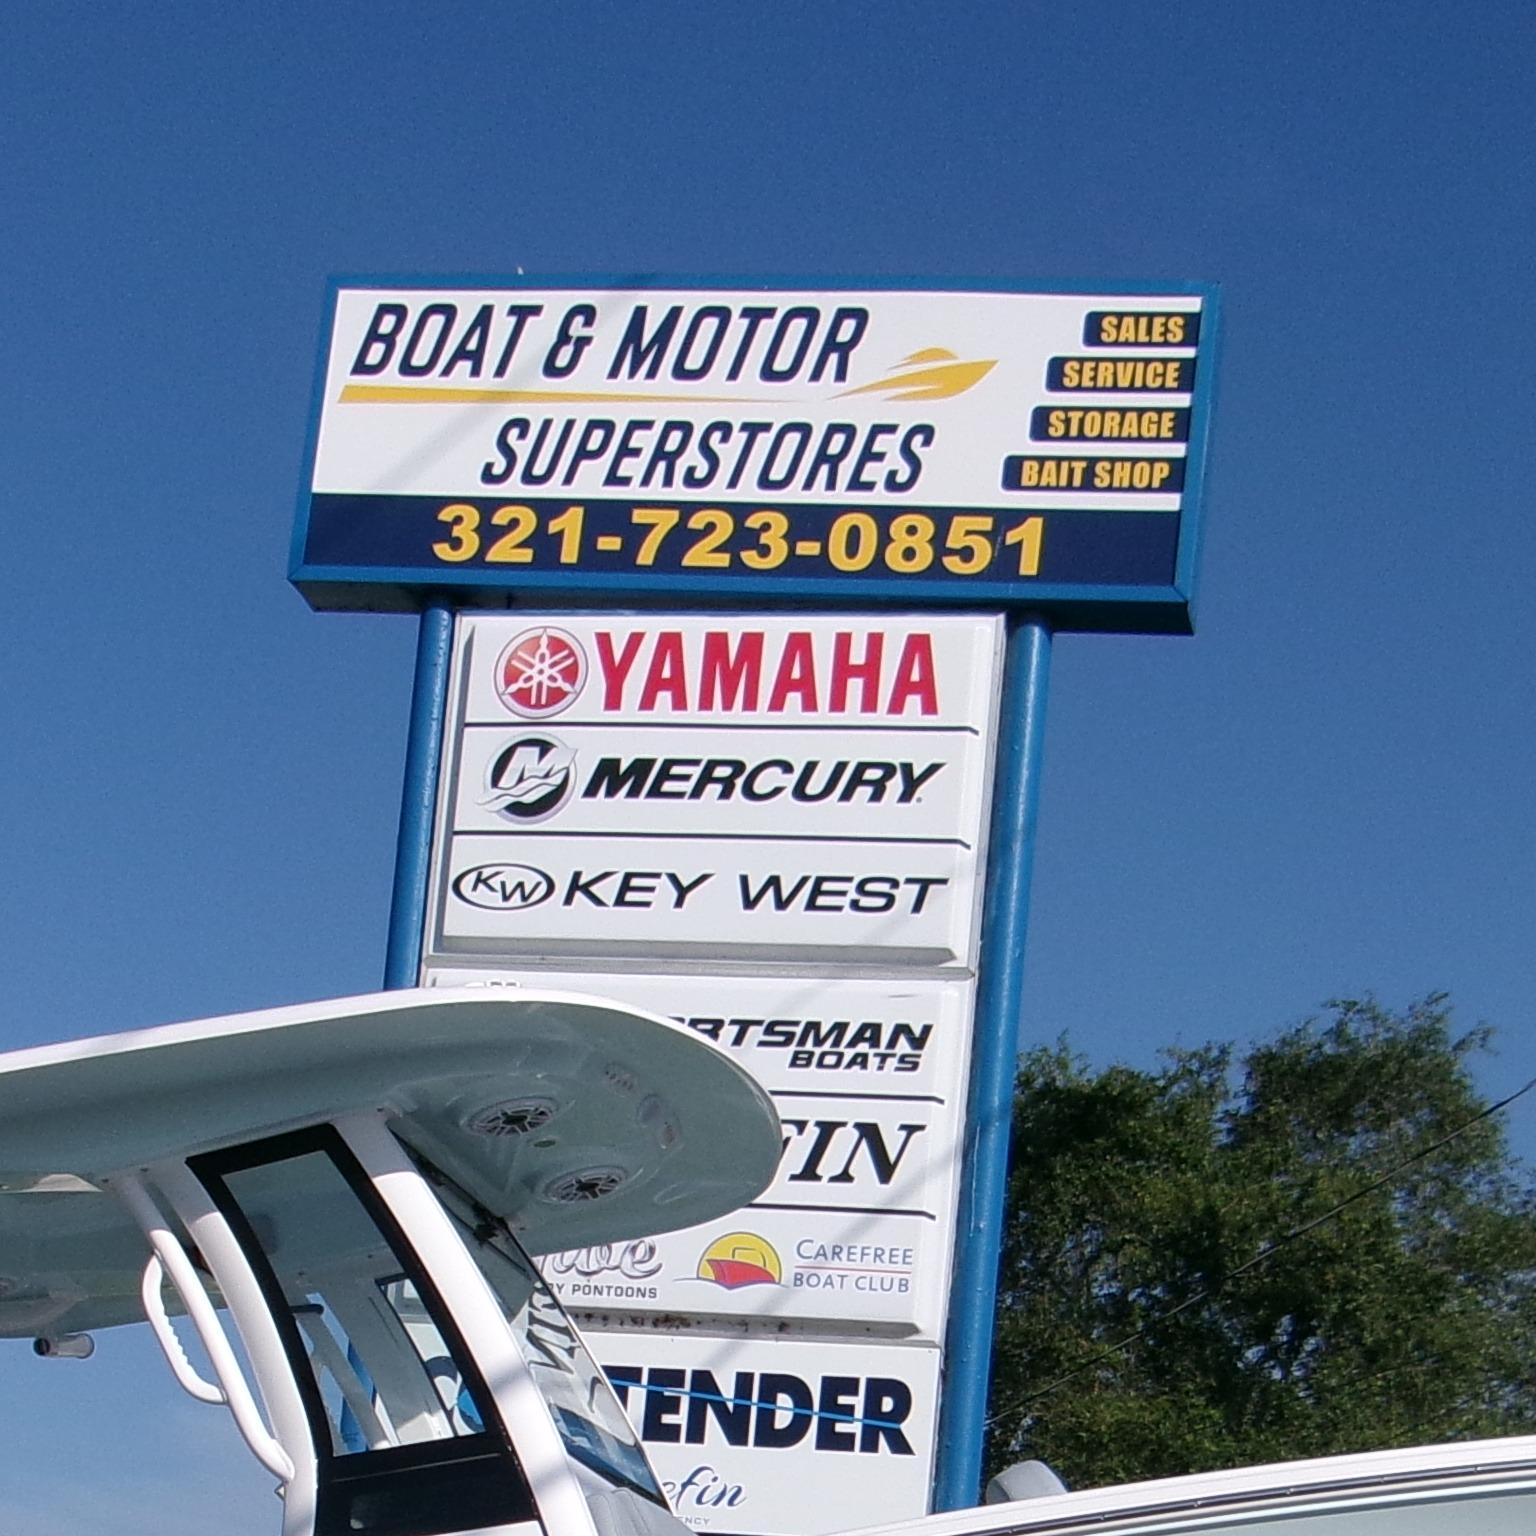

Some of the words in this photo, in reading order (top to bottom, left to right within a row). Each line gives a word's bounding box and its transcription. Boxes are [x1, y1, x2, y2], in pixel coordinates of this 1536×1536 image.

[350, 303, 543, 378] BOAT
[542, 304, 596, 378] &
[606, 305, 869, 382] MOTOR
[1100, 316, 1185, 343] SALES
[1062, 361, 1181, 389] SERVICE
[1048, 411, 1176, 438] STORAGE
[481, 418, 935, 494] SUPERSTORES
[1021, 460, 1088, 487] BAIT
[1093, 461, 1170, 489] SHOP
[431, 504, 1046, 578] 321-723-0851
[594, 631, 939, 716] YAMAHA
[581, 757, 946, 804] MERCURY
[470, 870, 543, 903] KW
[562, 870, 715, 909] KEY
[739, 874, 949, 914] WEST
[668, 1017, 934, 1051] RTSMAN
[787, 1050, 922, 1072] BOATS
[796, 1239, 913, 1265] CAREFREE
[571, 1283, 657, 1299] PONTOONS
[793, 1272, 848, 1290] BOAT
[855, 1276, 909, 1293] CLUB
